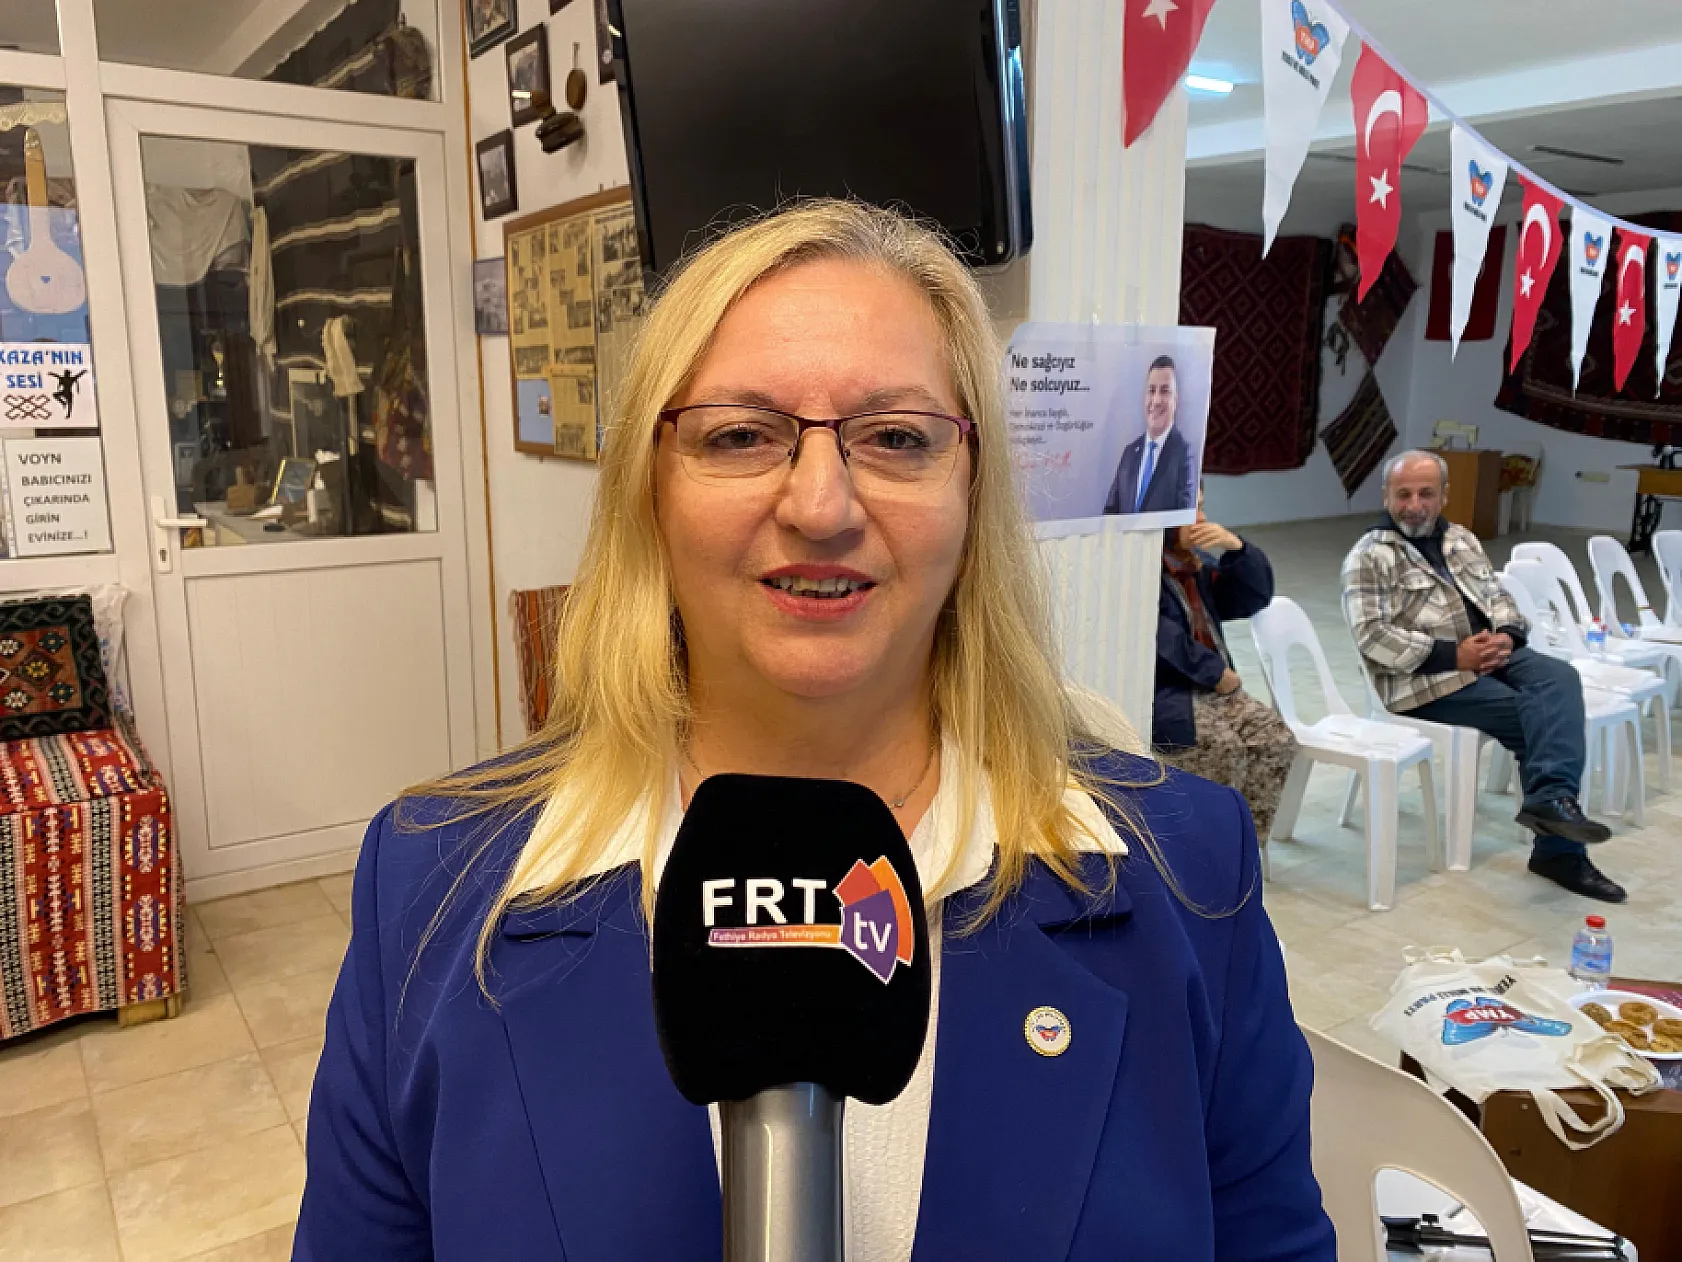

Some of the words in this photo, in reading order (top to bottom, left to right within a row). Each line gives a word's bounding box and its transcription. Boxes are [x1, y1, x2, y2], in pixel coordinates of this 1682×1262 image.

[6, 372, 43, 389] SESİ
[1010, 377, 1028, 392] Ne
[18, 453, 62, 465] VOYN
[23, 494, 91, 508] ÇIKARINDA
[25, 512, 60, 525] GİRİN
[702, 878, 828, 927] FRT
[853, 911, 892, 953] tv
